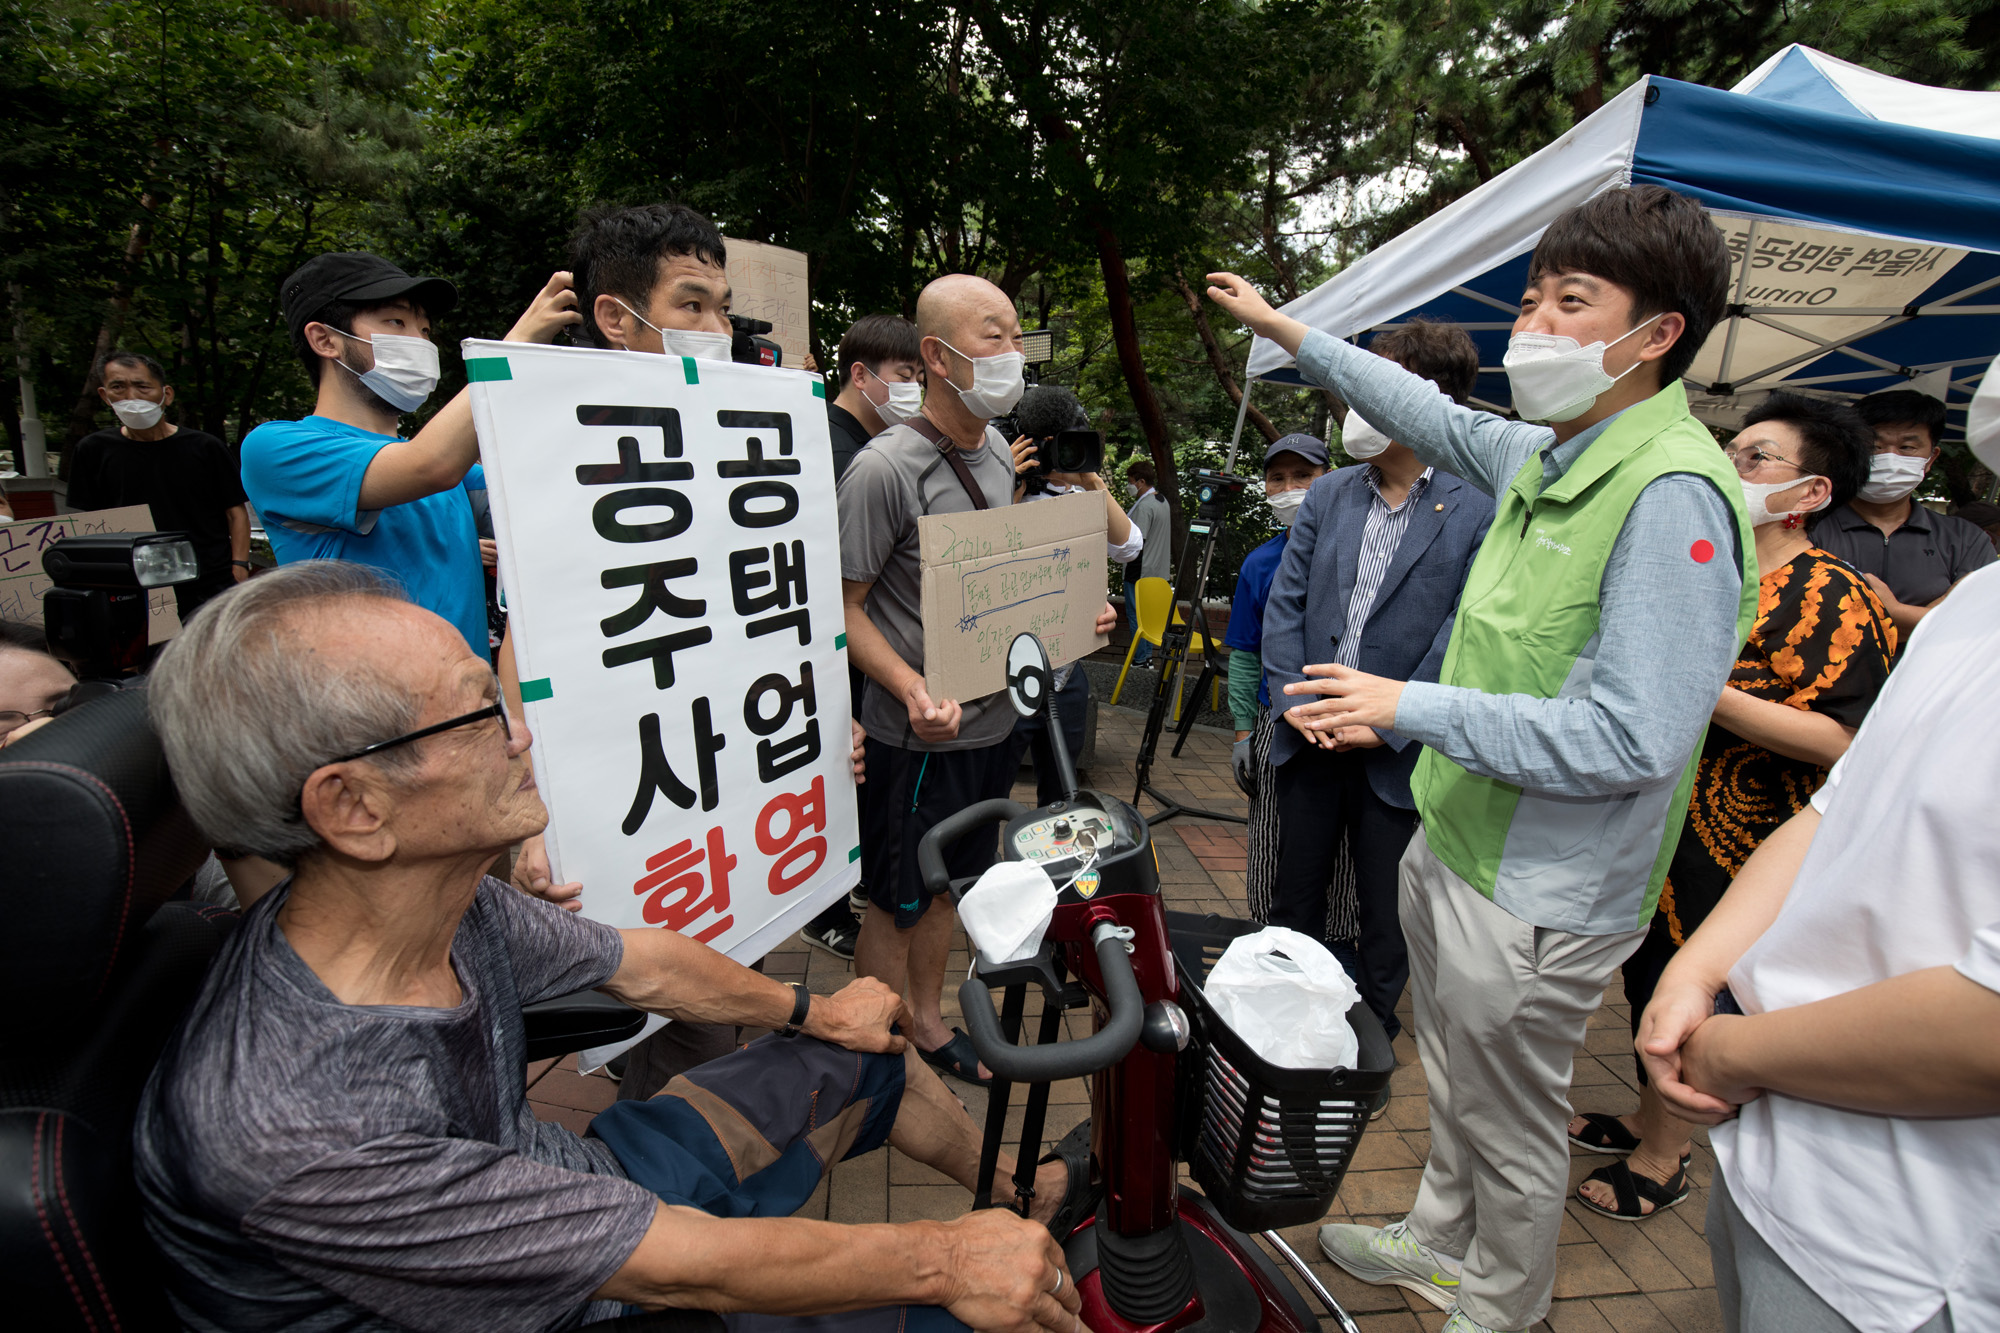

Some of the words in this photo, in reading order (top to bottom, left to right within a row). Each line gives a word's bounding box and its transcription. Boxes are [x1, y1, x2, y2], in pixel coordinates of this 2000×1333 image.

[575, 404, 801, 544] 공공
[600, 540, 812, 690] 주택
[967, 579, 992, 613] 동자동
[621, 661, 822, 836] 사업
[633, 775, 828, 944] 환영
